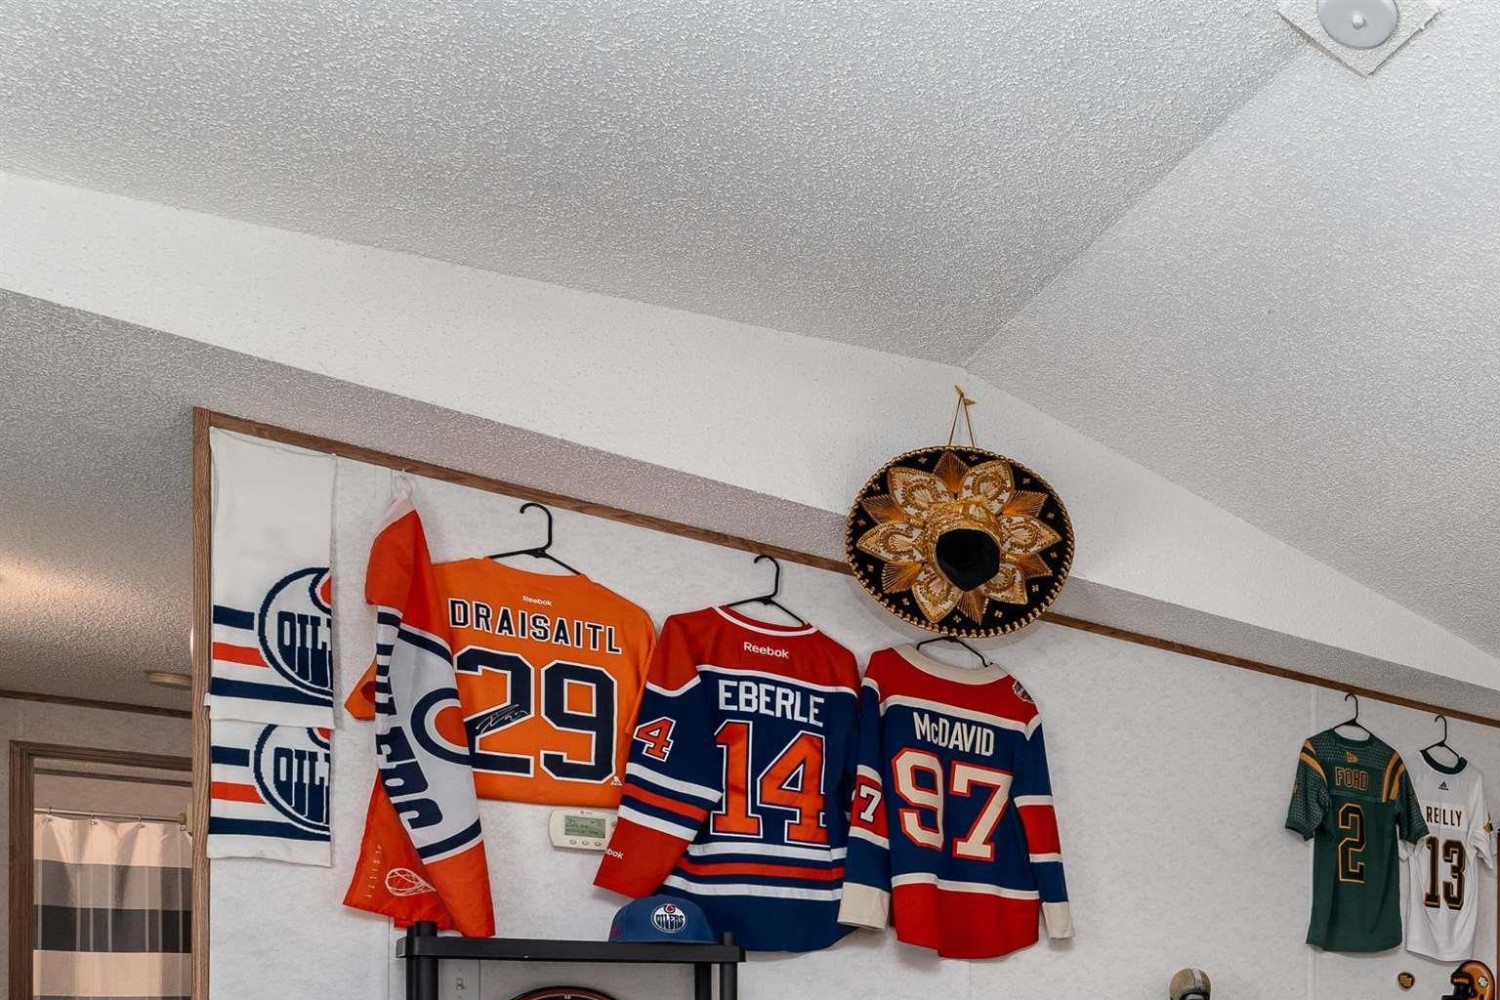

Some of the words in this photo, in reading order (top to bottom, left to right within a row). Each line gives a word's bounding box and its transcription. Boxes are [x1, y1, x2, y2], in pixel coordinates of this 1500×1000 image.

[448, 598, 622, 654] DRAISAITL
[522, 596, 553, 607] Reebok
[277, 610, 333, 690] OIL
[743, 641, 790, 659] Reebok
[453, 645, 617, 784] 29
[718, 679, 825, 728] EBERLE
[633, 716, 676, 762] 4
[913, 711, 995, 757] McDAVID
[710, 719, 831, 848] 14
[1334, 766, 1369, 791] FORD
[890, 747, 1014, 863] 97
[1426, 806, 1462, 827] REILLY
[1338, 803, 1366, 884] 2
[1424, 836, 1467, 911] 13
[655, 912, 685, 930] OILERS
